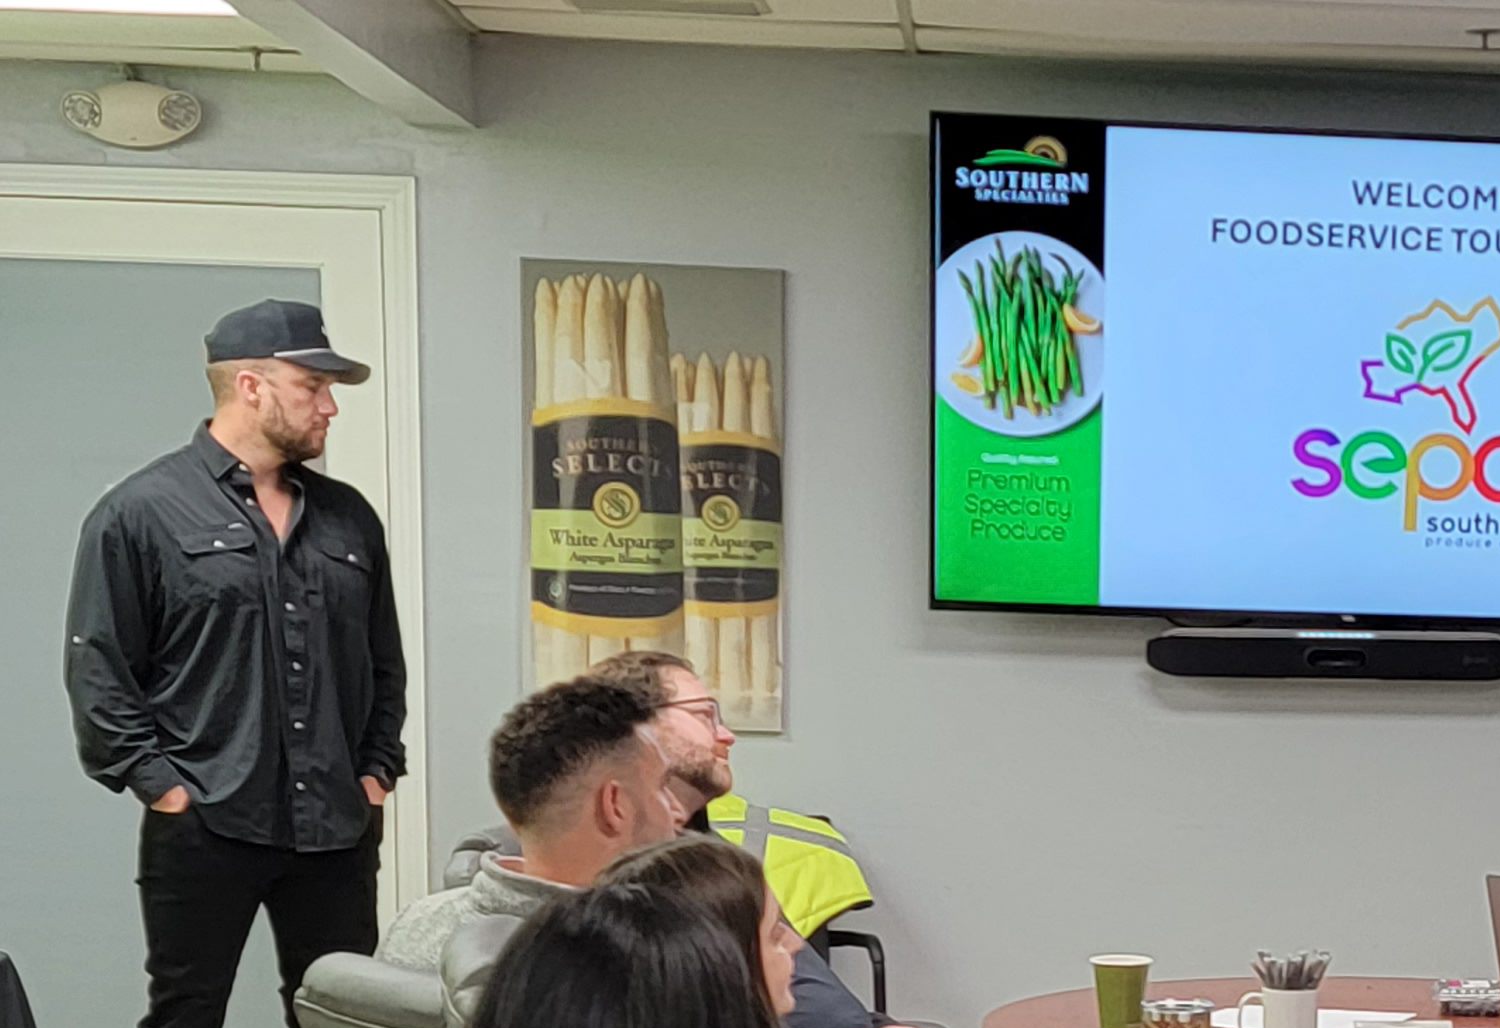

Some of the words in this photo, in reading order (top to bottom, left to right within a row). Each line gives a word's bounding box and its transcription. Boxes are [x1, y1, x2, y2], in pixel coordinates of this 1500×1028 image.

[955, 166, 1089, 193] SOUTHERN
[974, 188, 1070, 206] SPECIALTIES
[1211, 218, 1443, 252] FOODSERVICE
[967, 469, 1070, 492] Premium
[964, 493, 1072, 523] Specialty
[549, 528, 599, 548] White
[970, 518, 1066, 542] Produce
[1425, 535, 1492, 547] produce
